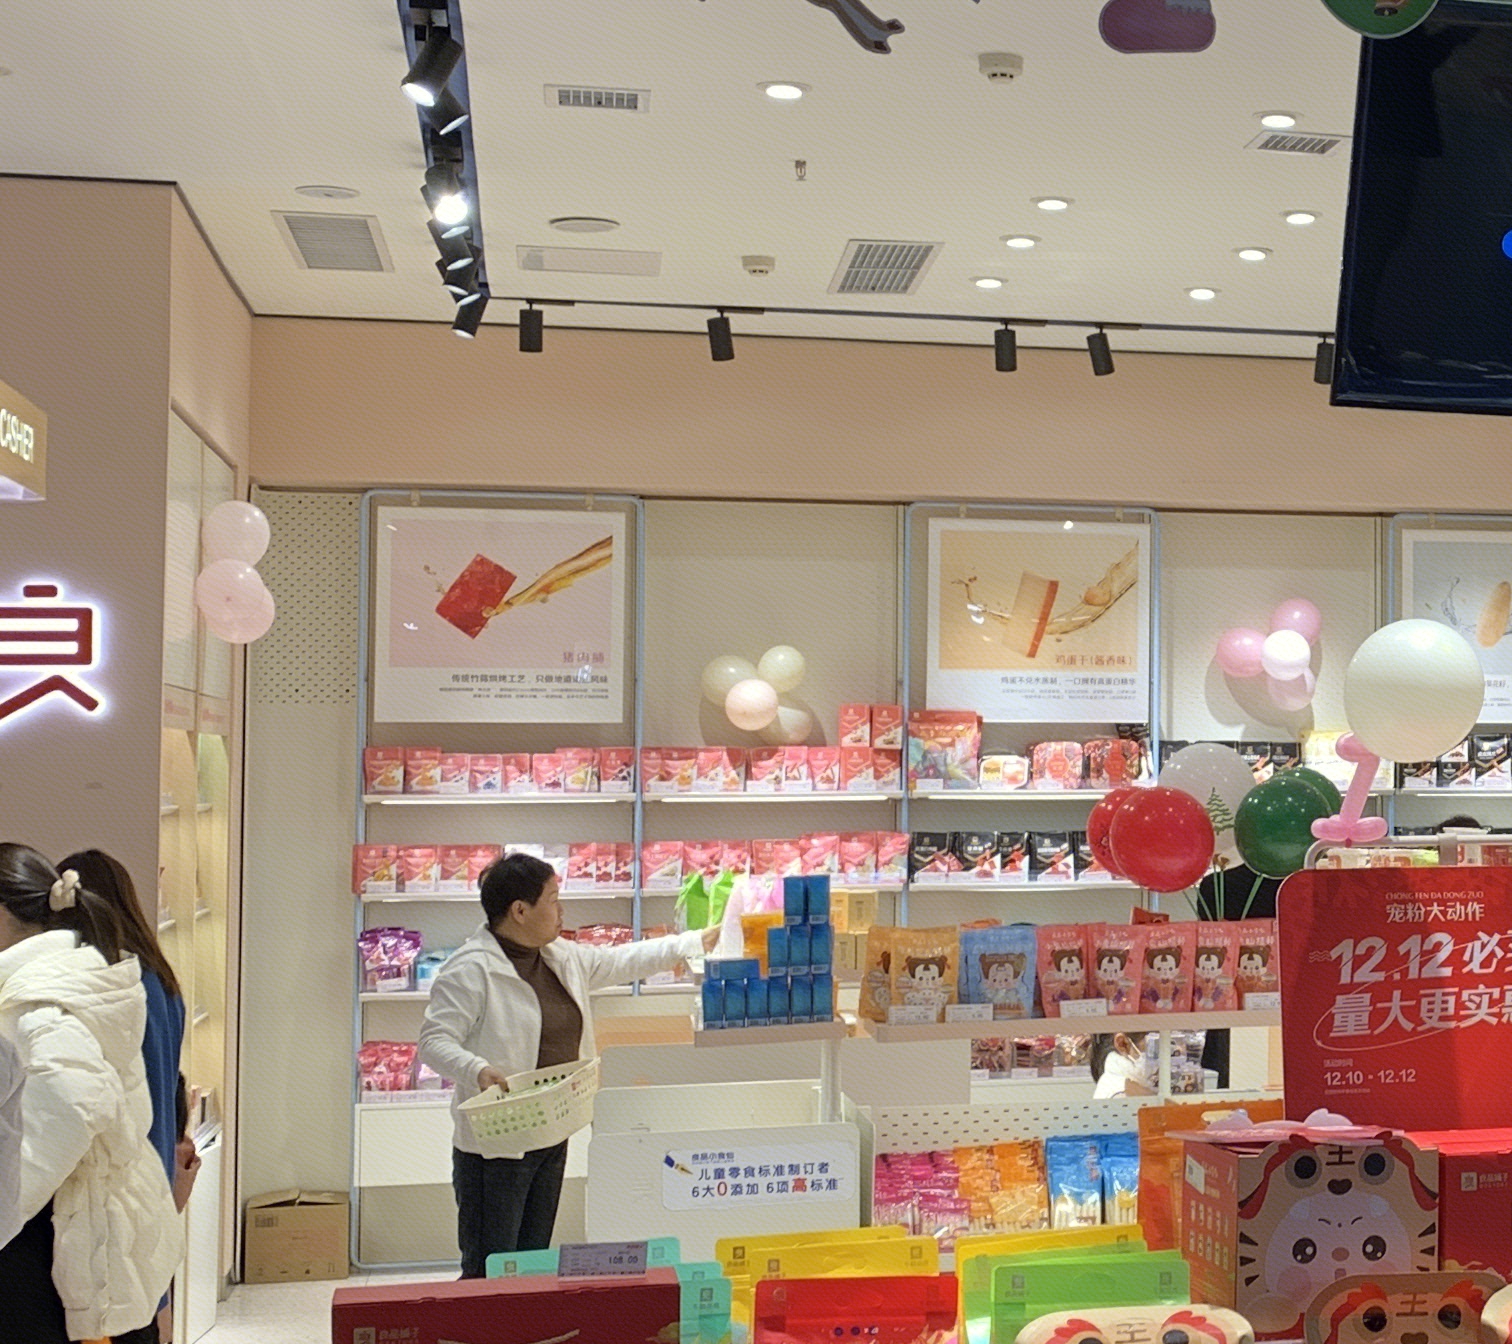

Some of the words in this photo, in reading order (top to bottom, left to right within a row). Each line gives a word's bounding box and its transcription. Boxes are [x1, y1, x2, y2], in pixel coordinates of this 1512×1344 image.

[1443, 891, 1466, 900] DONG
[1467, 891, 1484, 899] ZUO
[1386, 901, 1485, 924] 宠粉大动作
[1324, 1070, 1364, 1086] 12.10
[1377, 1068, 1416, 1084] 12.12
[698, 1161, 831, 1182] 儿童零食标准制订者
[691, 1180, 759, 1198] 6大0添加
[766, 1176, 839, 1194] 6项高标准
